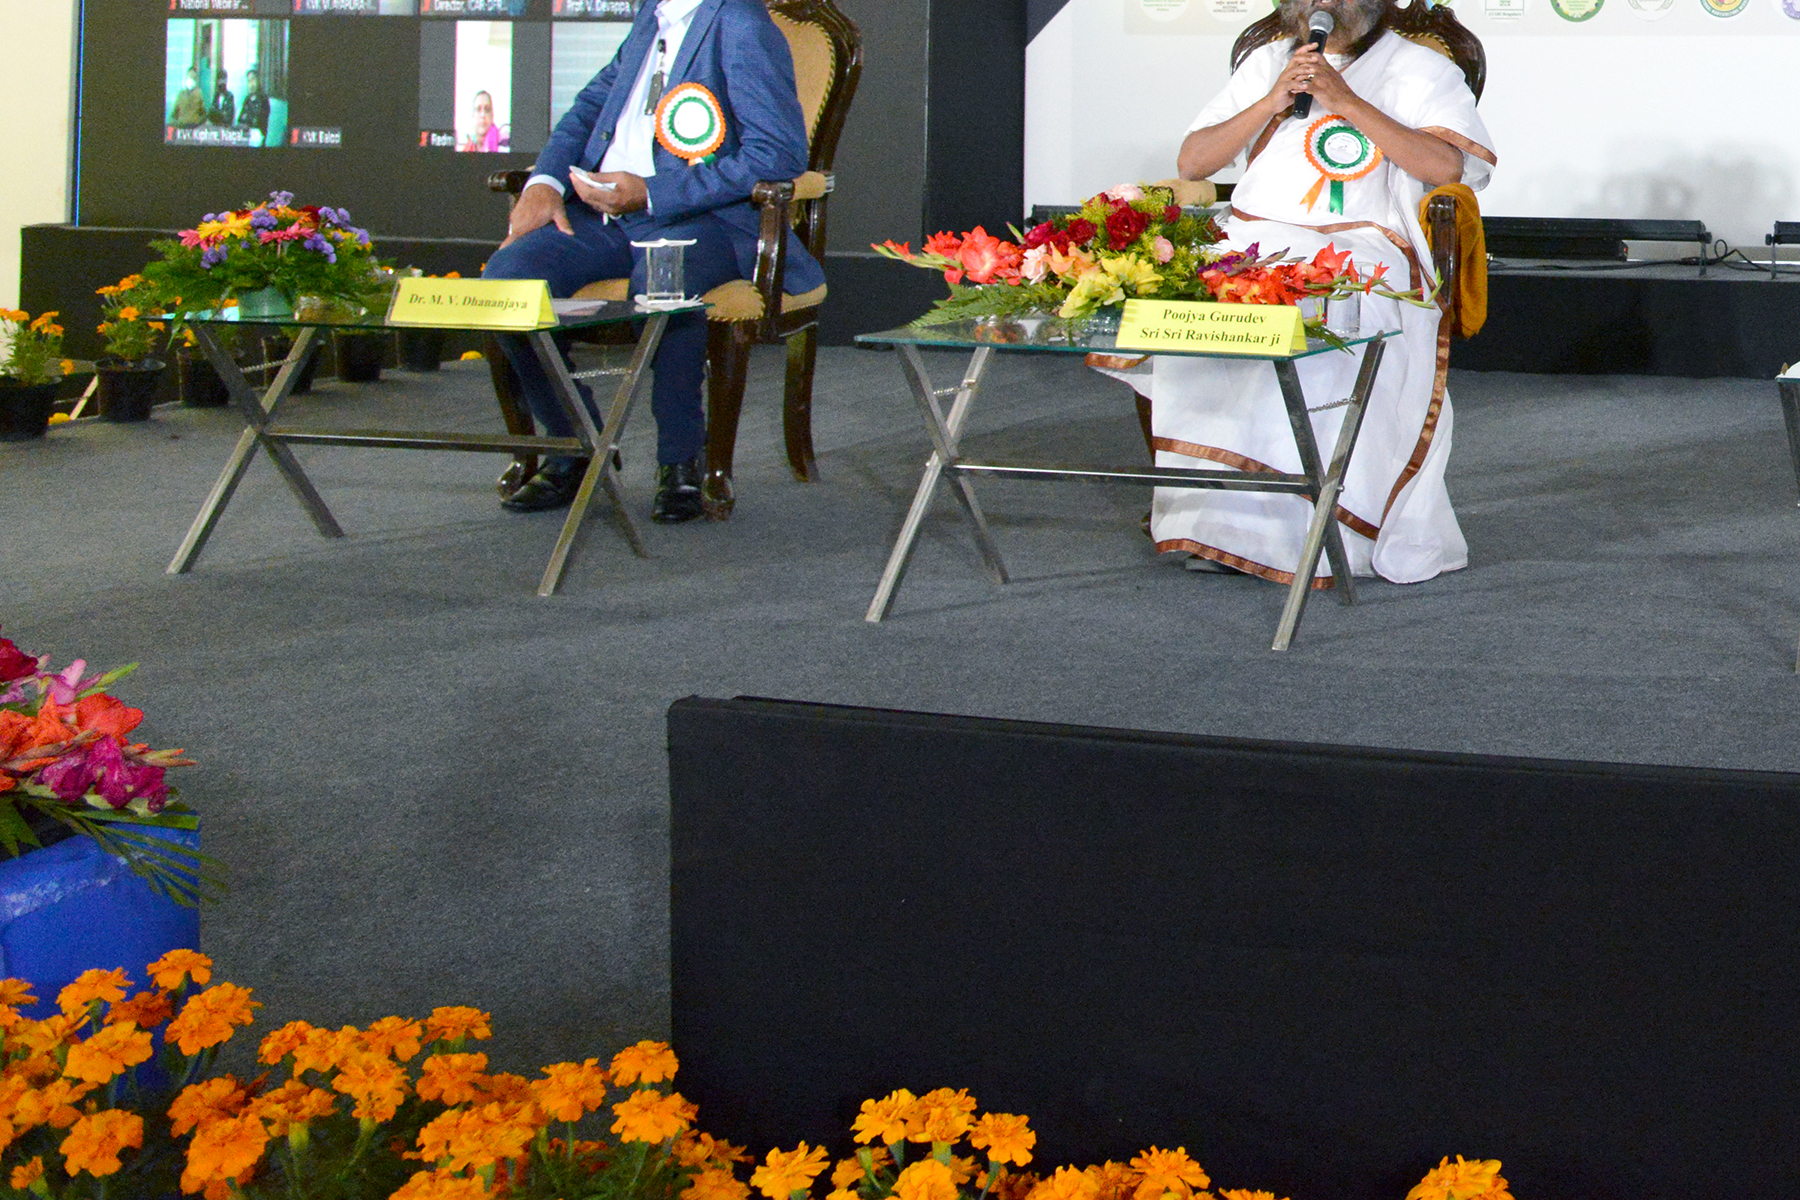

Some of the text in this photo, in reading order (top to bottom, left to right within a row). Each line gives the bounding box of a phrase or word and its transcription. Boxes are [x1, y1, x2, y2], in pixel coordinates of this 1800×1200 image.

[408, 293, 528, 311] Dr. M. V. Dhananjaya
[1162, 308, 1267, 325] Poojya Gurudev
[1140, 326, 1281, 347] Sri Sri Ravishankar ji
